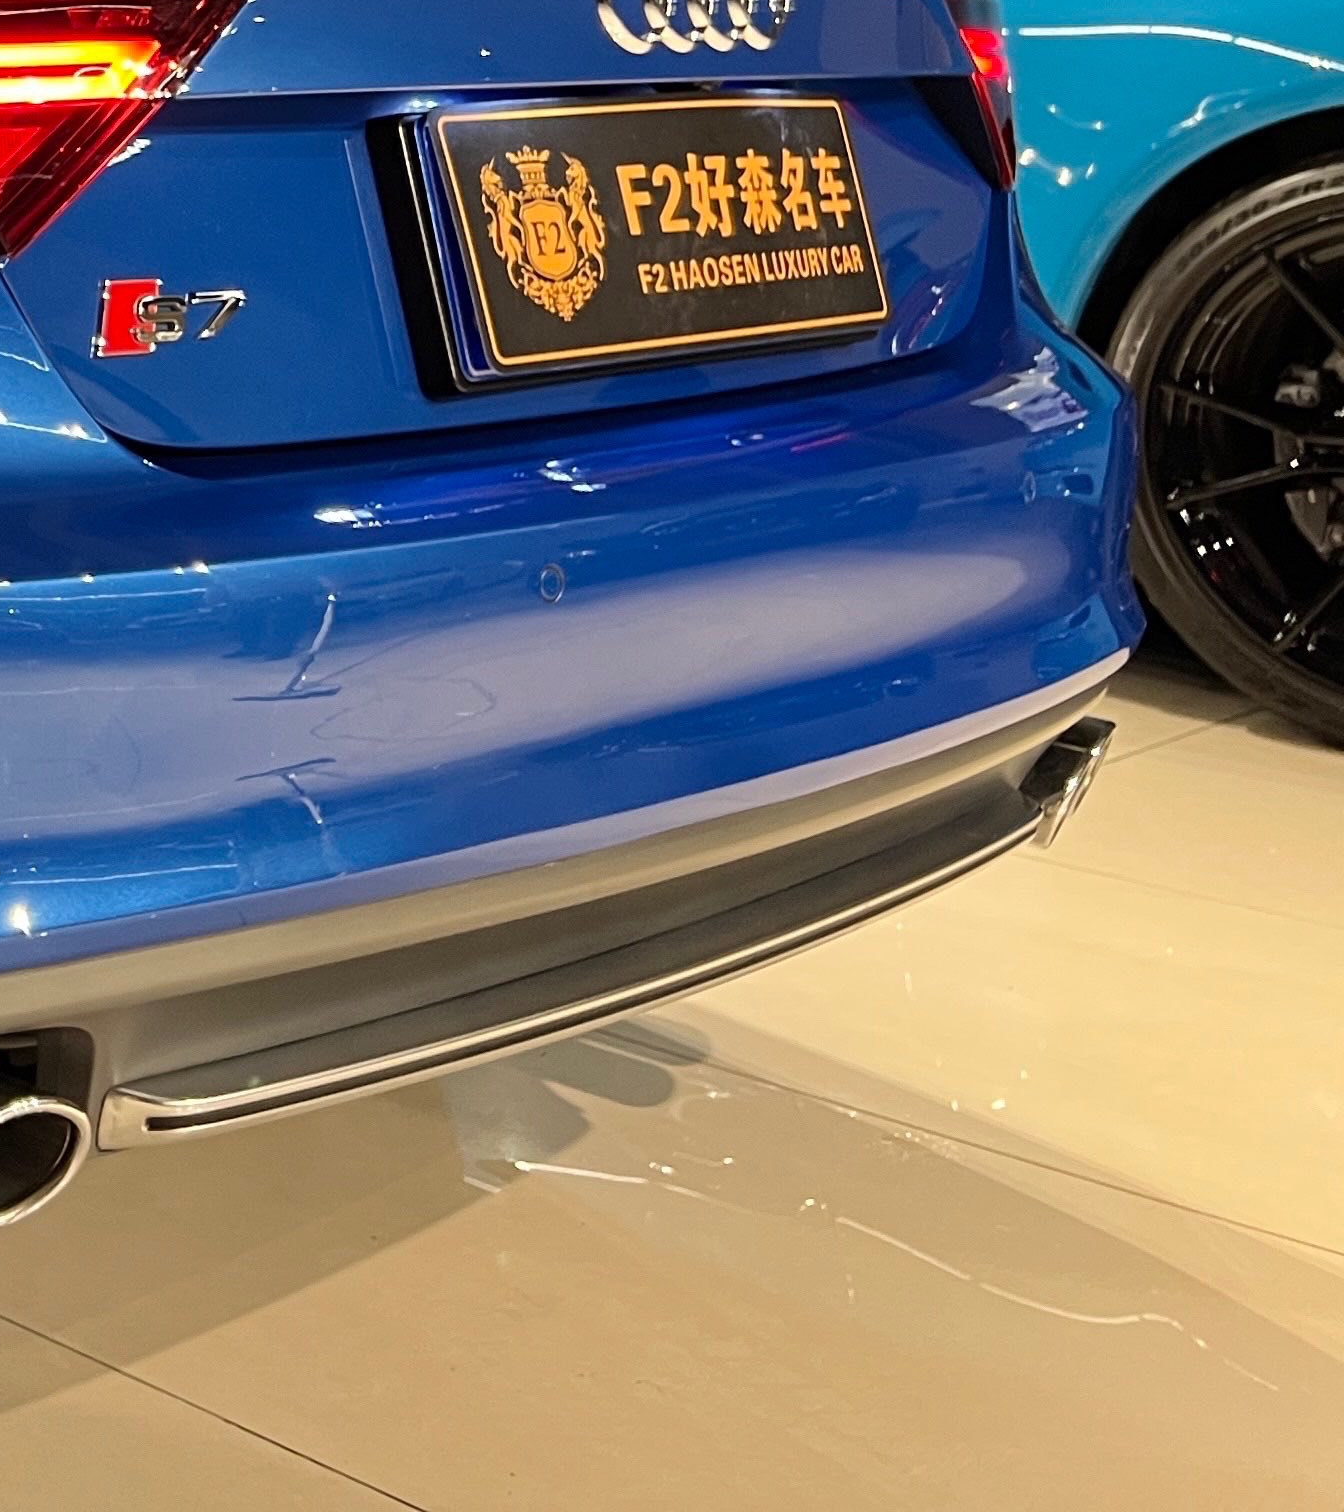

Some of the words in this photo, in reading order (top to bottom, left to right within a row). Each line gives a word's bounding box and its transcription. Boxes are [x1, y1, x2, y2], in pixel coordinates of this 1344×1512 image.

[615, 147, 853, 238] F2好森名车
[530, 219, 568, 257] F2
[637, 262, 669, 295] F2
[669, 252, 761, 292] HAOSEN
[761, 246, 829, 282] LUXURY
[830, 243, 865, 275] CAR
[128, 289, 248, 344] S7
